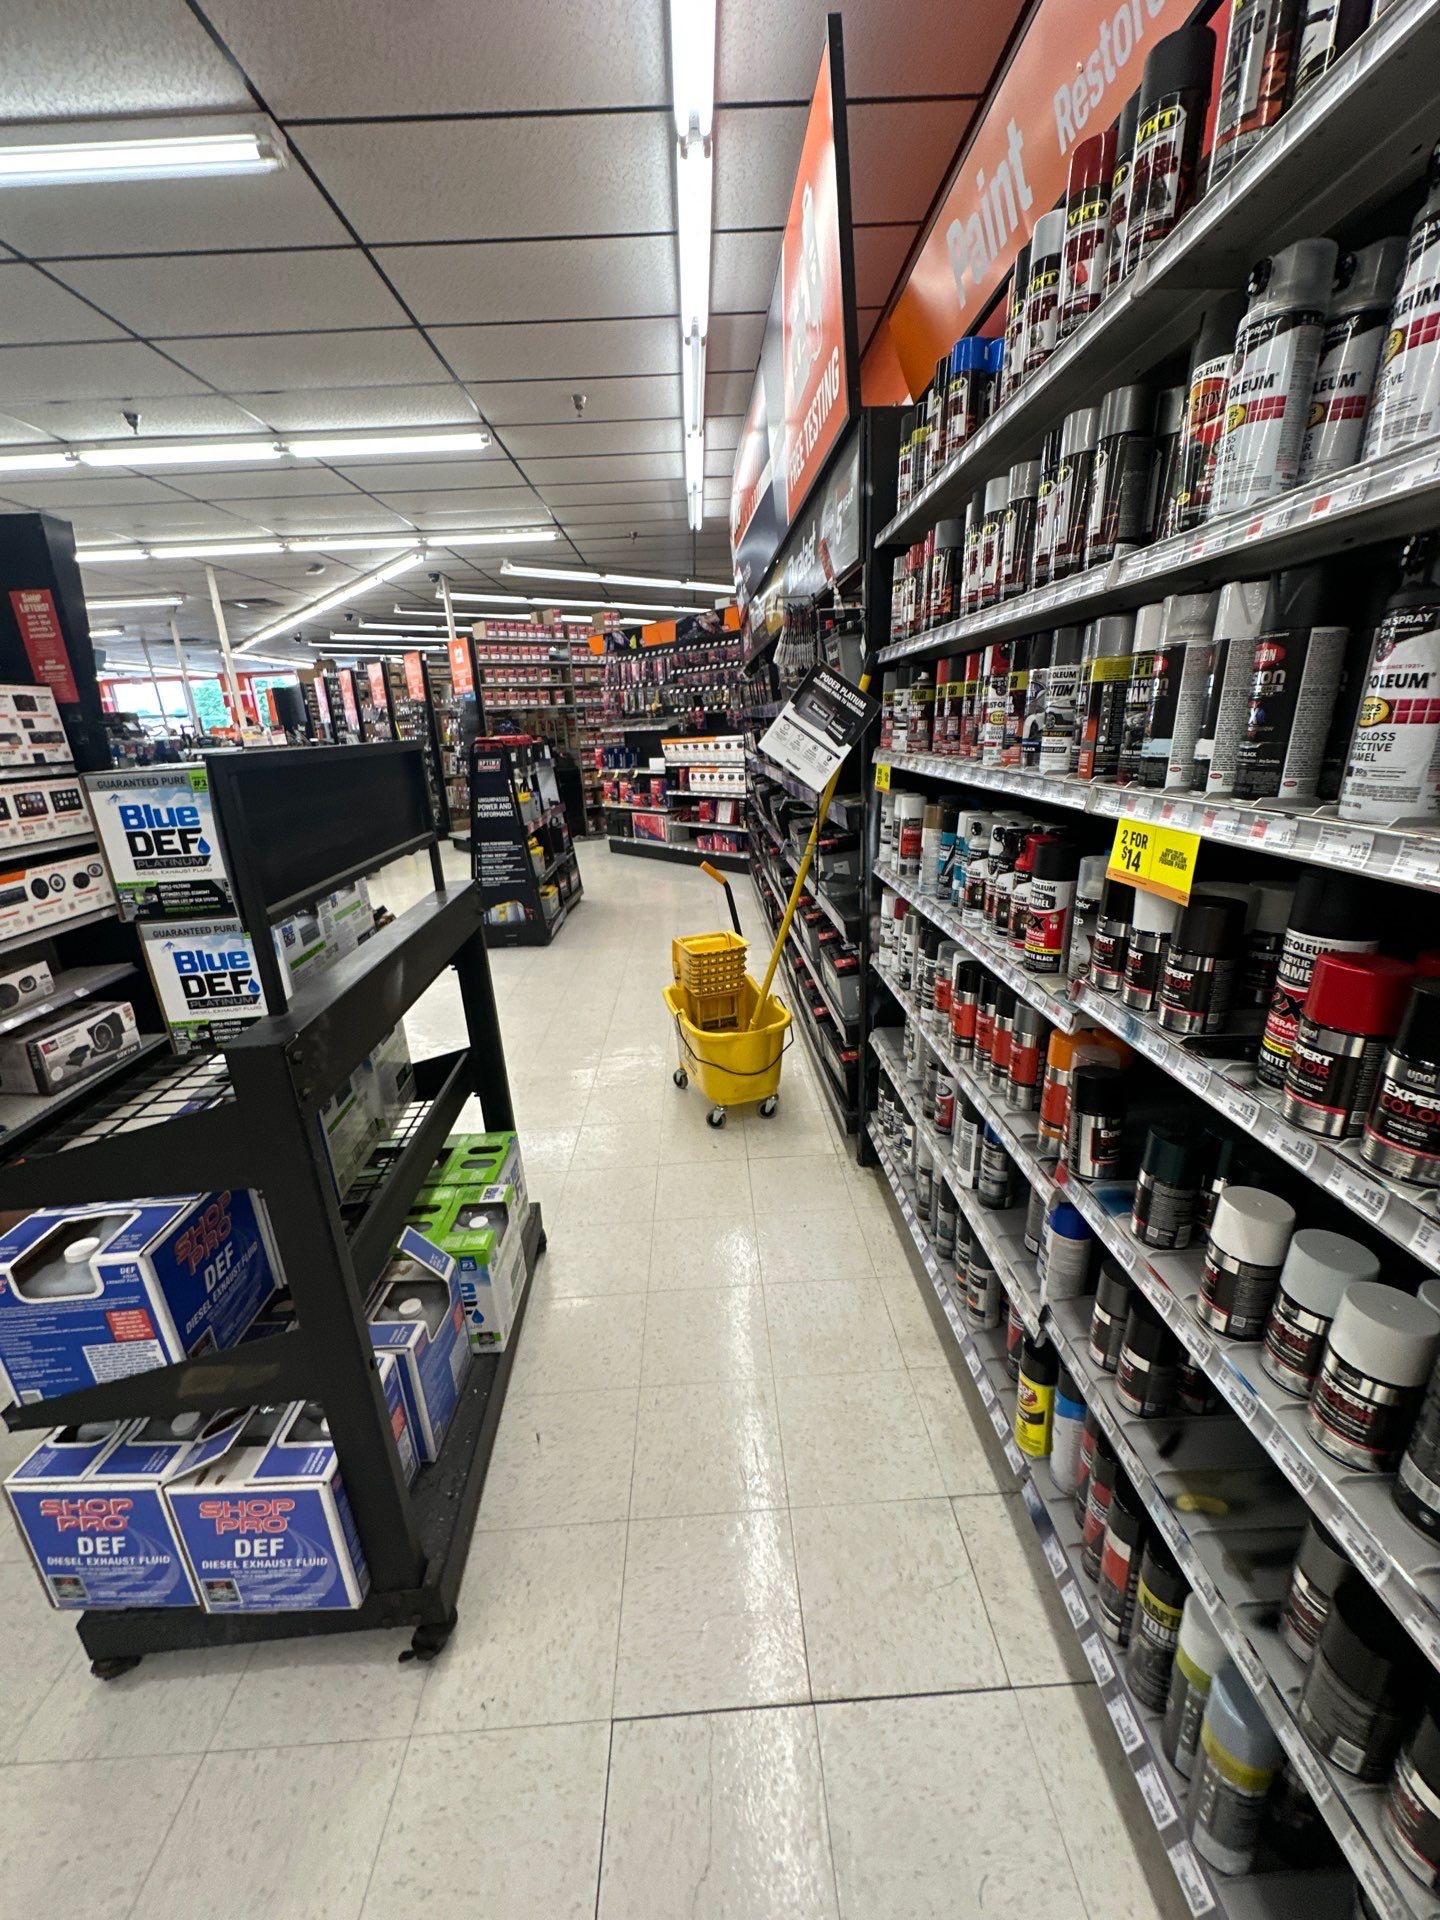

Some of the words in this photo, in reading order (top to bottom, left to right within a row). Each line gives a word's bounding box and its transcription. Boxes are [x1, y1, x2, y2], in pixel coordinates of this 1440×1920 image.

[1137, 108, 1176, 144] VHT
[946, 117, 1033, 309] Paint
[1069, 203, 1103, 226] VHT
[1029, 272, 1056, 294] VHT
[803, 345, 840, 458] TESTING
[835, 500, 843, 545] 5
[1392, 613, 1433, 624] SPRAY
[819, 671, 841, 691] PODER
[840, 686, 867, 711] PLATIUM
[97, 778, 159, 790] GUARANTEED
[161, 776, 186, 786] PURE
[119, 804, 200, 830] Blue
[477, 810, 513, 818] PERFORMANCE
[478, 803, 498, 811] POWER
[126, 828, 202, 858] DEF
[1121, 829, 1128, 844] 2
[1130, 831, 1148, 849] FOR
[137, 858, 204, 869] PLATINUM
[1121, 846, 1141, 873] $14
[161, 868, 192, 876] EXHAUST
[153, 927, 212, 939] GUARANTEED
[214, 924, 238, 934] PURE
[173, 950, 250, 974] Blue
[1036, 954, 1053, 962] BLACK
[1279, 961, 1313, 983] AME
[180, 970, 252, 999] DEF
[190, 997, 254, 1008] PLATINUM
[1381, 1093, 1440, 1125] COLO
[175, 1189, 231, 1266] SHOP
[188, 1215, 232, 1276] PRO
[120, 1267, 136, 1275] DEF
[204, 1241, 234, 1294] DEF
[186, 1301, 213, 1335] DIESEL
[213, 1263, 242, 1301] EXHAUST
[242, 1240, 258, 1267] FLUID
[40, 1498, 134, 1518] SHOP
[199, 1498, 295, 1519] SHOP
[57, 1515, 128, 1533] PRO
[216, 1515, 288, 1535] PRO
[77, 1536, 126, 1555] DEF
[234, 1538, 284, 1558] DEF
[47, 1557, 84, 1566] DIESEL
[87, 1556, 135, 1565] EXHAUST
[138, 1556, 171, 1564] FLUID
[202, 1560, 240, 1569] DIESEL
[242, 1559, 292, 1568] EXHAUST
[296, 1557, 328, 1566] FLUID
